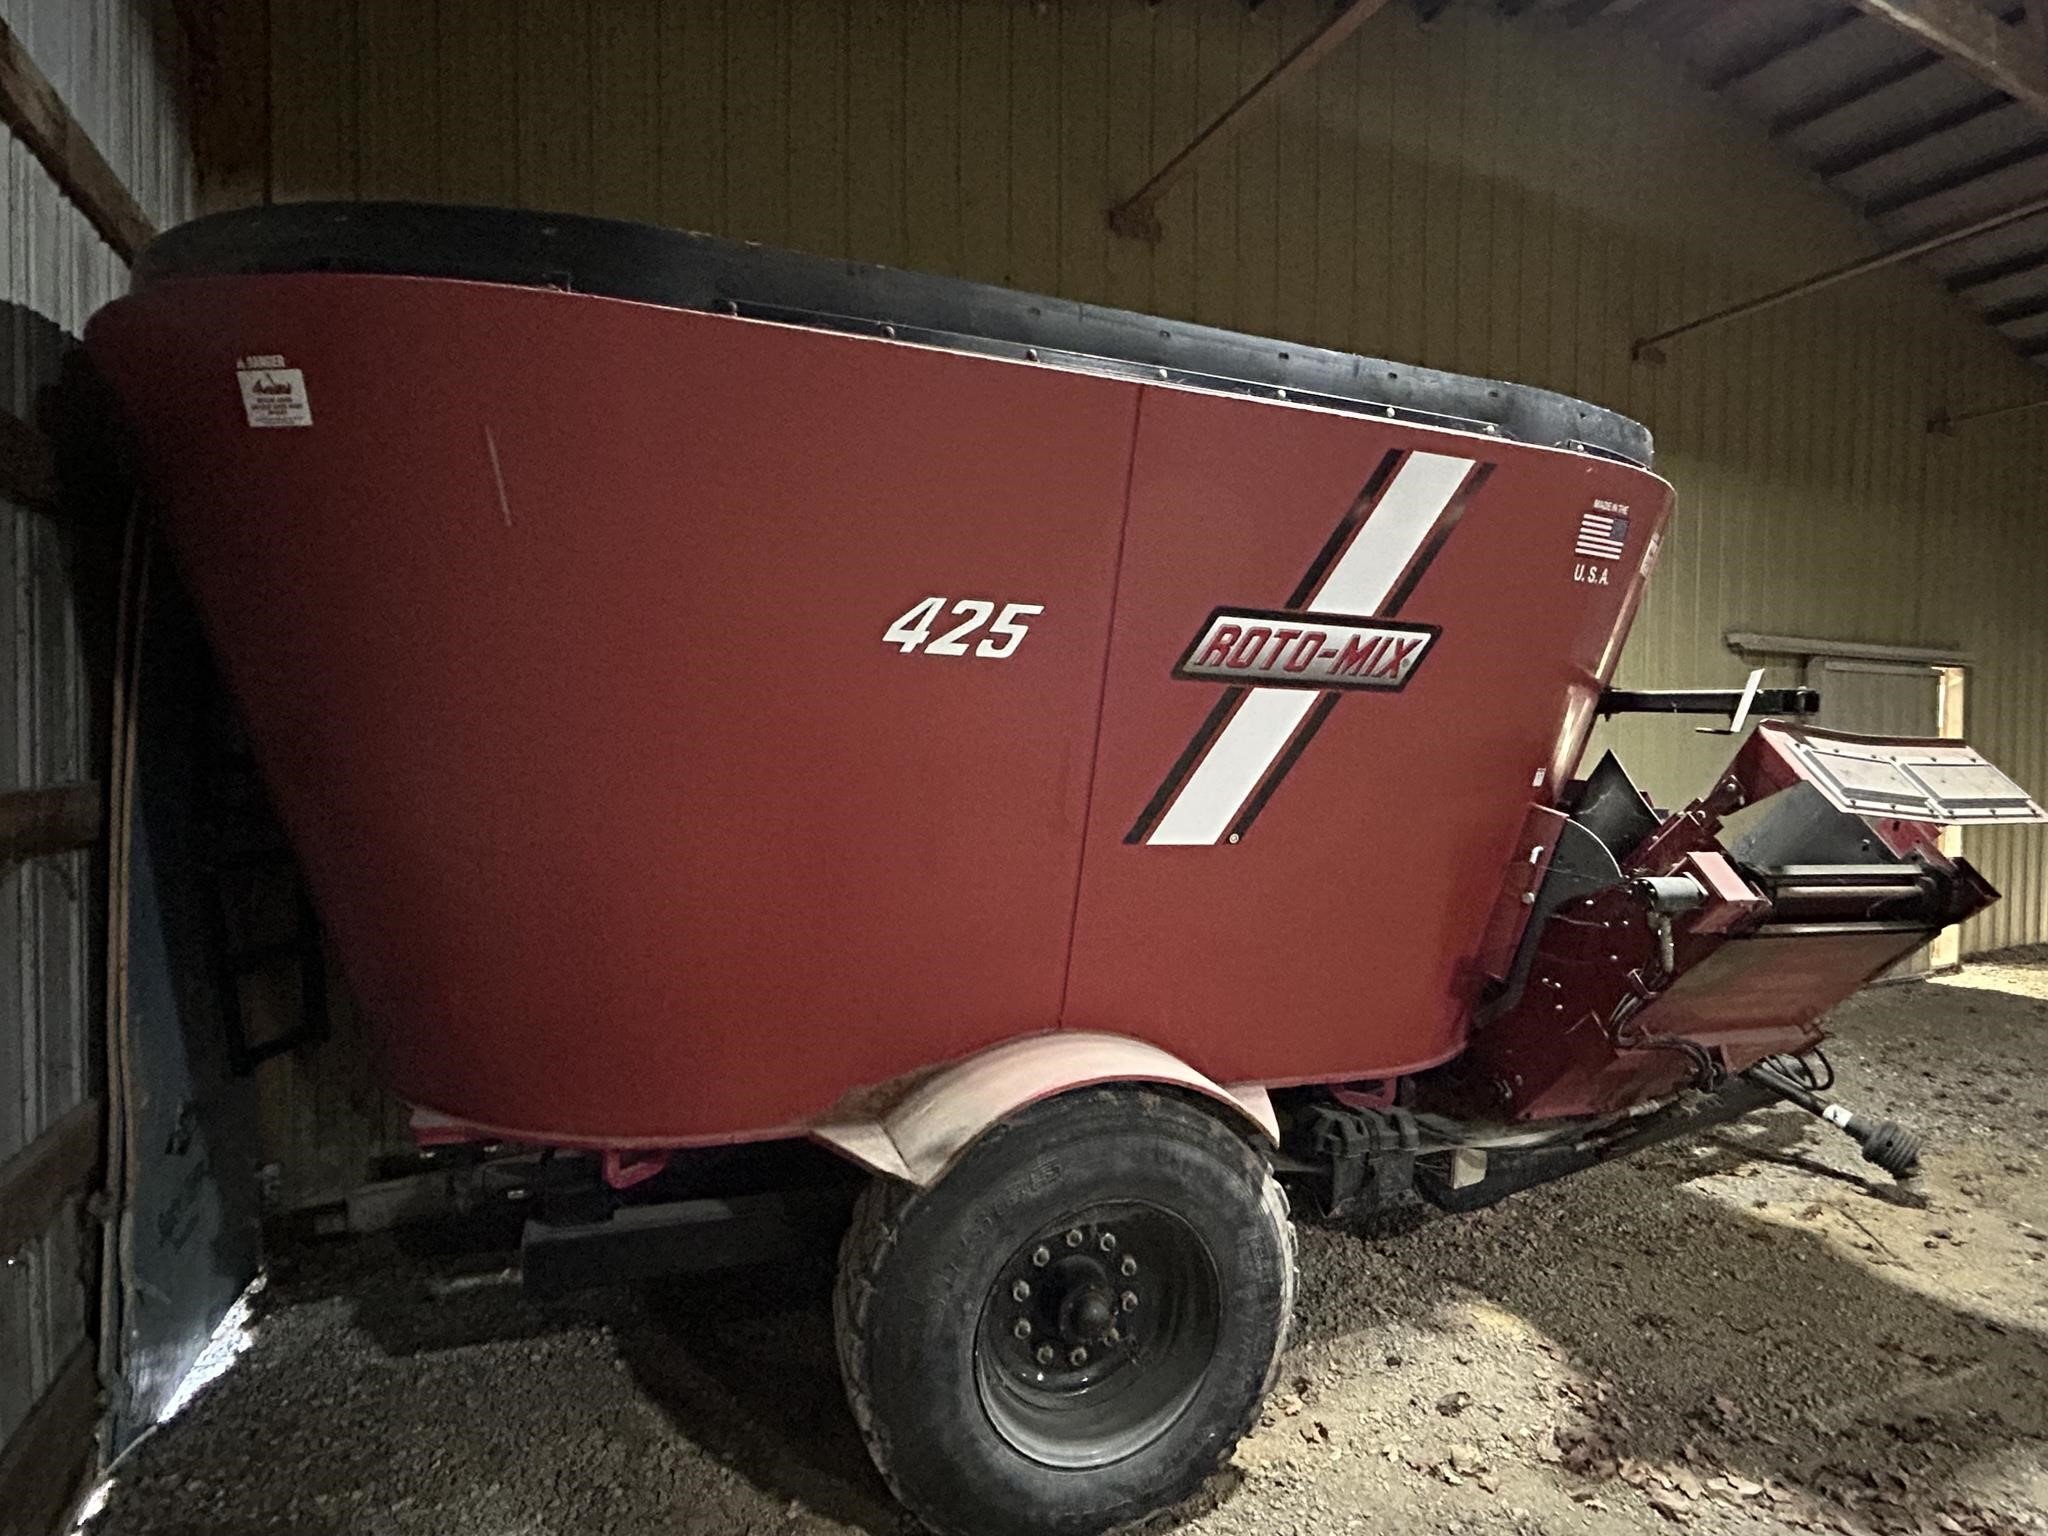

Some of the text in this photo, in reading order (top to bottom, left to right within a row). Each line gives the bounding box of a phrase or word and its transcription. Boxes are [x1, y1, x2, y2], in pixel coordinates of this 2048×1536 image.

[1593, 499, 1612, 511] MADE
[1618, 504, 1630, 515] THE
[882, 597, 1045, 658] 425
[1194, 623, 1422, 679] ROTO-MIX
